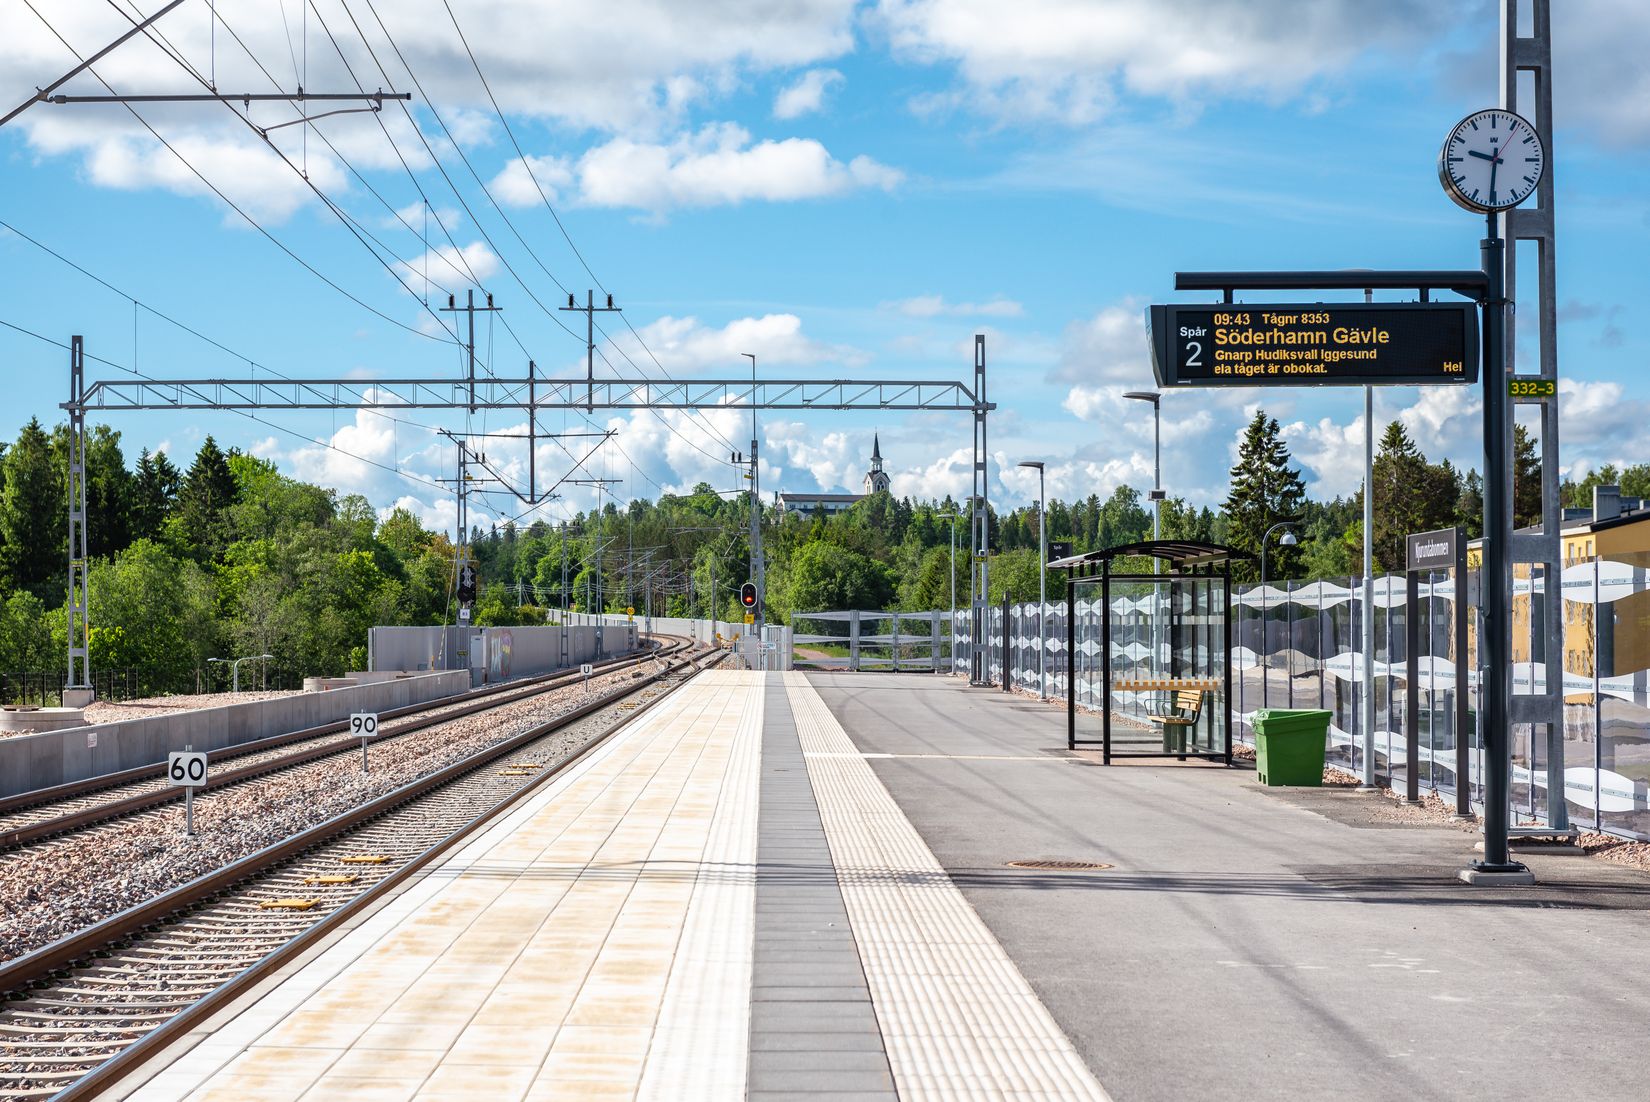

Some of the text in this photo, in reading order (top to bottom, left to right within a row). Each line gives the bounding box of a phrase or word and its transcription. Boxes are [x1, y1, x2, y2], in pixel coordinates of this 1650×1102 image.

[1213, 312, 1330, 327] 09:43 Tågnr 8353
[1179, 326, 1207, 339] Spår
[1214, 326, 1390, 345] Söderhamn Gävle
[1185, 341, 1202, 366] 2
[1214, 348, 1377, 363] Gnarp Hudiksvall Iggesund
[1214, 362, 1328, 377] ela tåget är obokat.
[1443, 361, 1463, 372] Hel
[1511, 382, 1554, 395] 332-3
[583, 665, 590, 674] U
[352, 716, 376, 734] 90
[170, 757, 205, 781] 60
